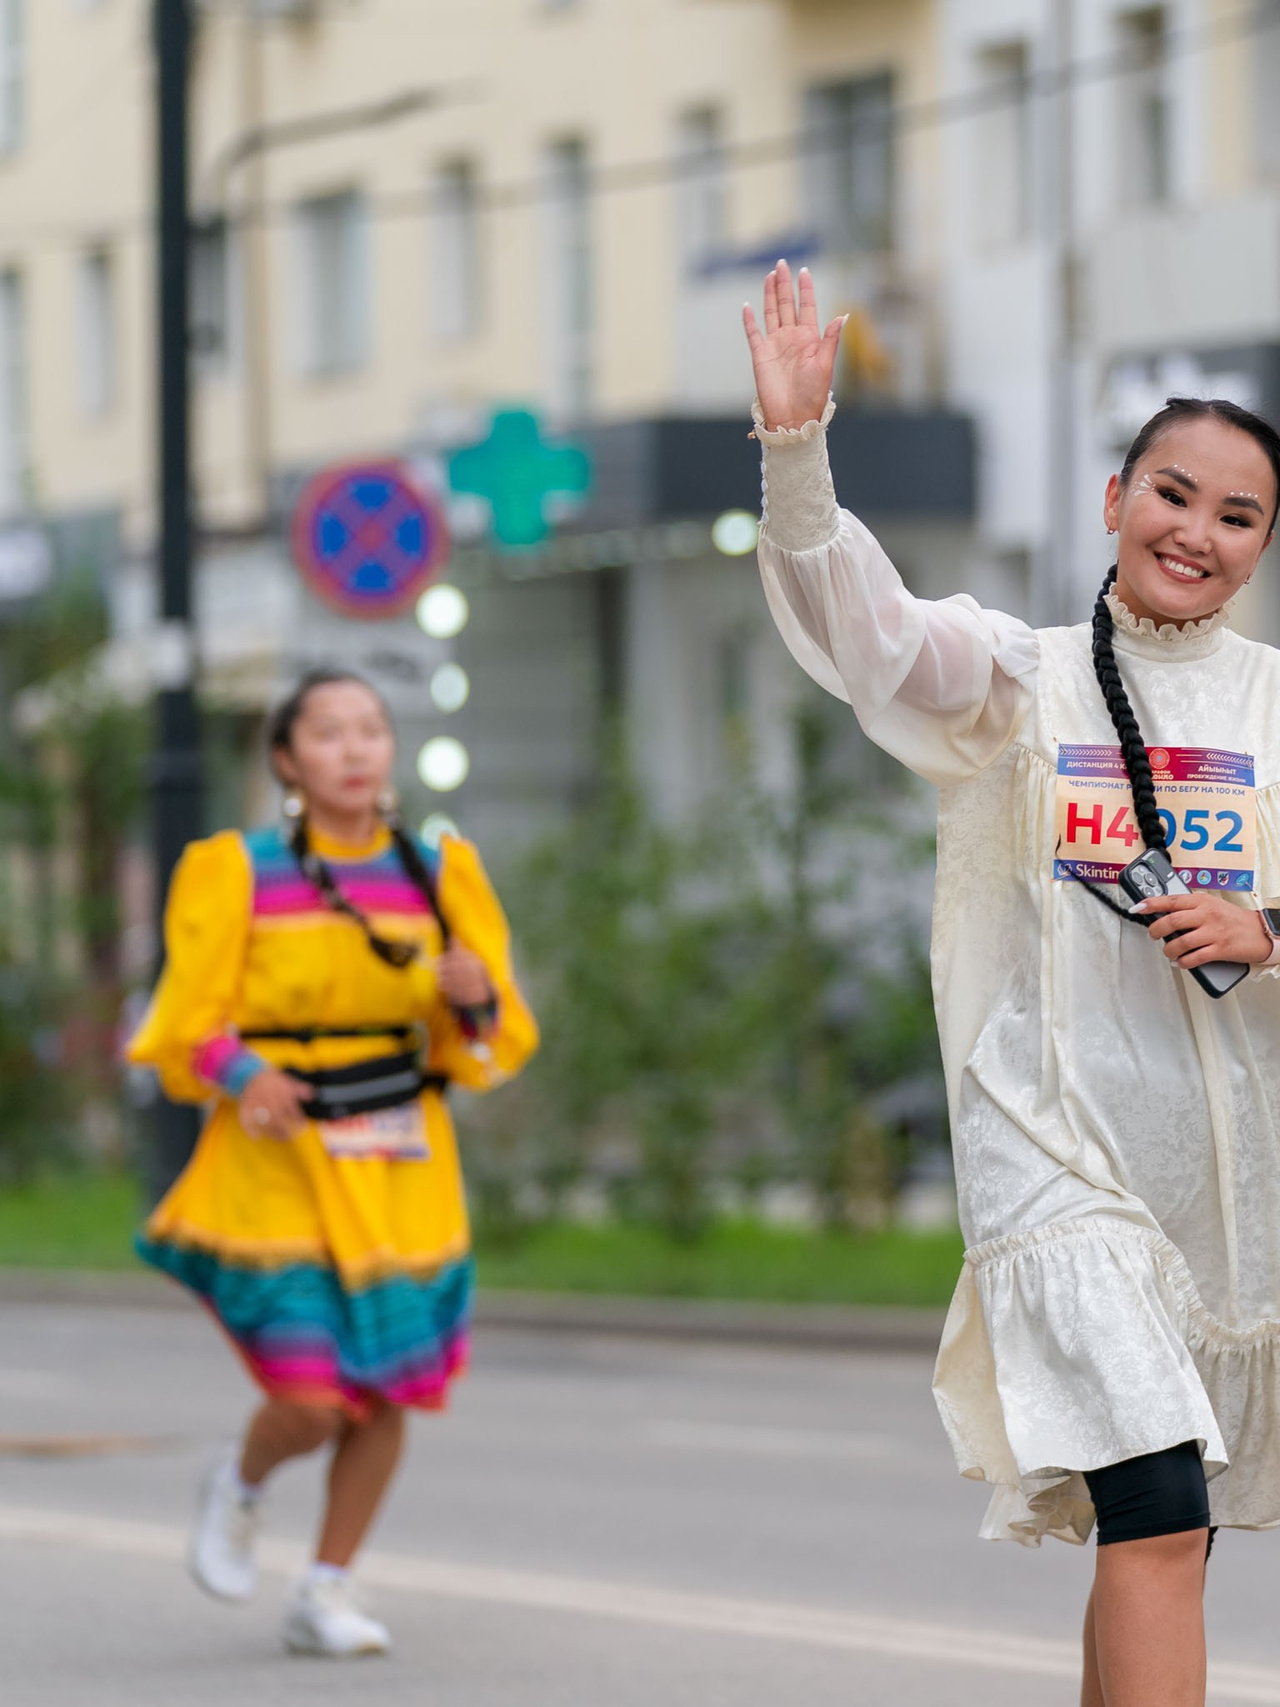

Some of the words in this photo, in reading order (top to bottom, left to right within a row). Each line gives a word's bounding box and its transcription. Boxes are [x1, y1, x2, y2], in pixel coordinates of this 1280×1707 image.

[1066, 761, 1113, 769] ДИСТАНЦИЯ
[1068, 779, 1125, 790] ЧЕМПИОНАТ
[1164, 785, 1177, 793] ПО
[1179, 785, 1199, 793] БЕГУ
[1201, 786, 1214, 794] НА
[1216, 787, 1231, 795] 100
[1232, 788, 1245, 797] КМ
